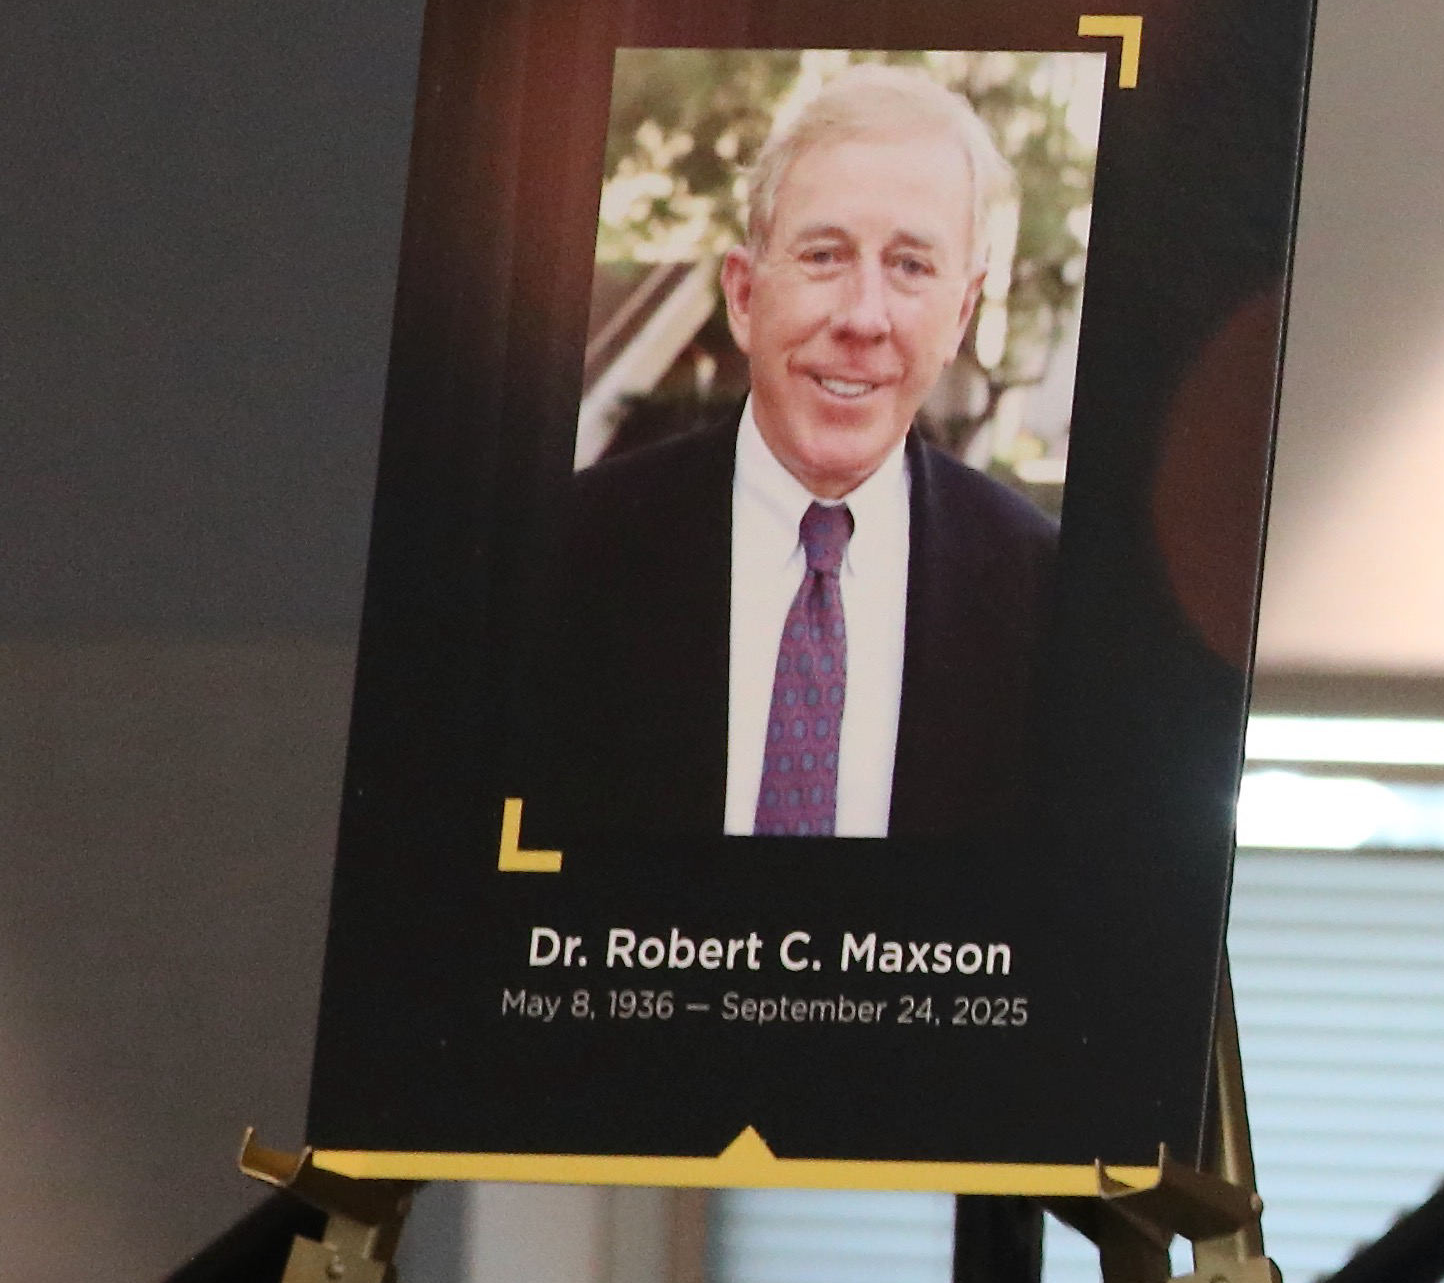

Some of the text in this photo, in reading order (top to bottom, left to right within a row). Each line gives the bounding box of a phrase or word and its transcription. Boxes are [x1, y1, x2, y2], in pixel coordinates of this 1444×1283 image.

[529, 926, 1011, 976] Dr. Robert C. Maxson
[501, 987, 561, 1023] May
[570, 989, 595, 1021] 8,
[609, 989, 675, 1020] 1936
[721, 991, 888, 1025] September
[896, 994, 940, 1027] 24,
[951, 995, 1028, 1027] 2025
